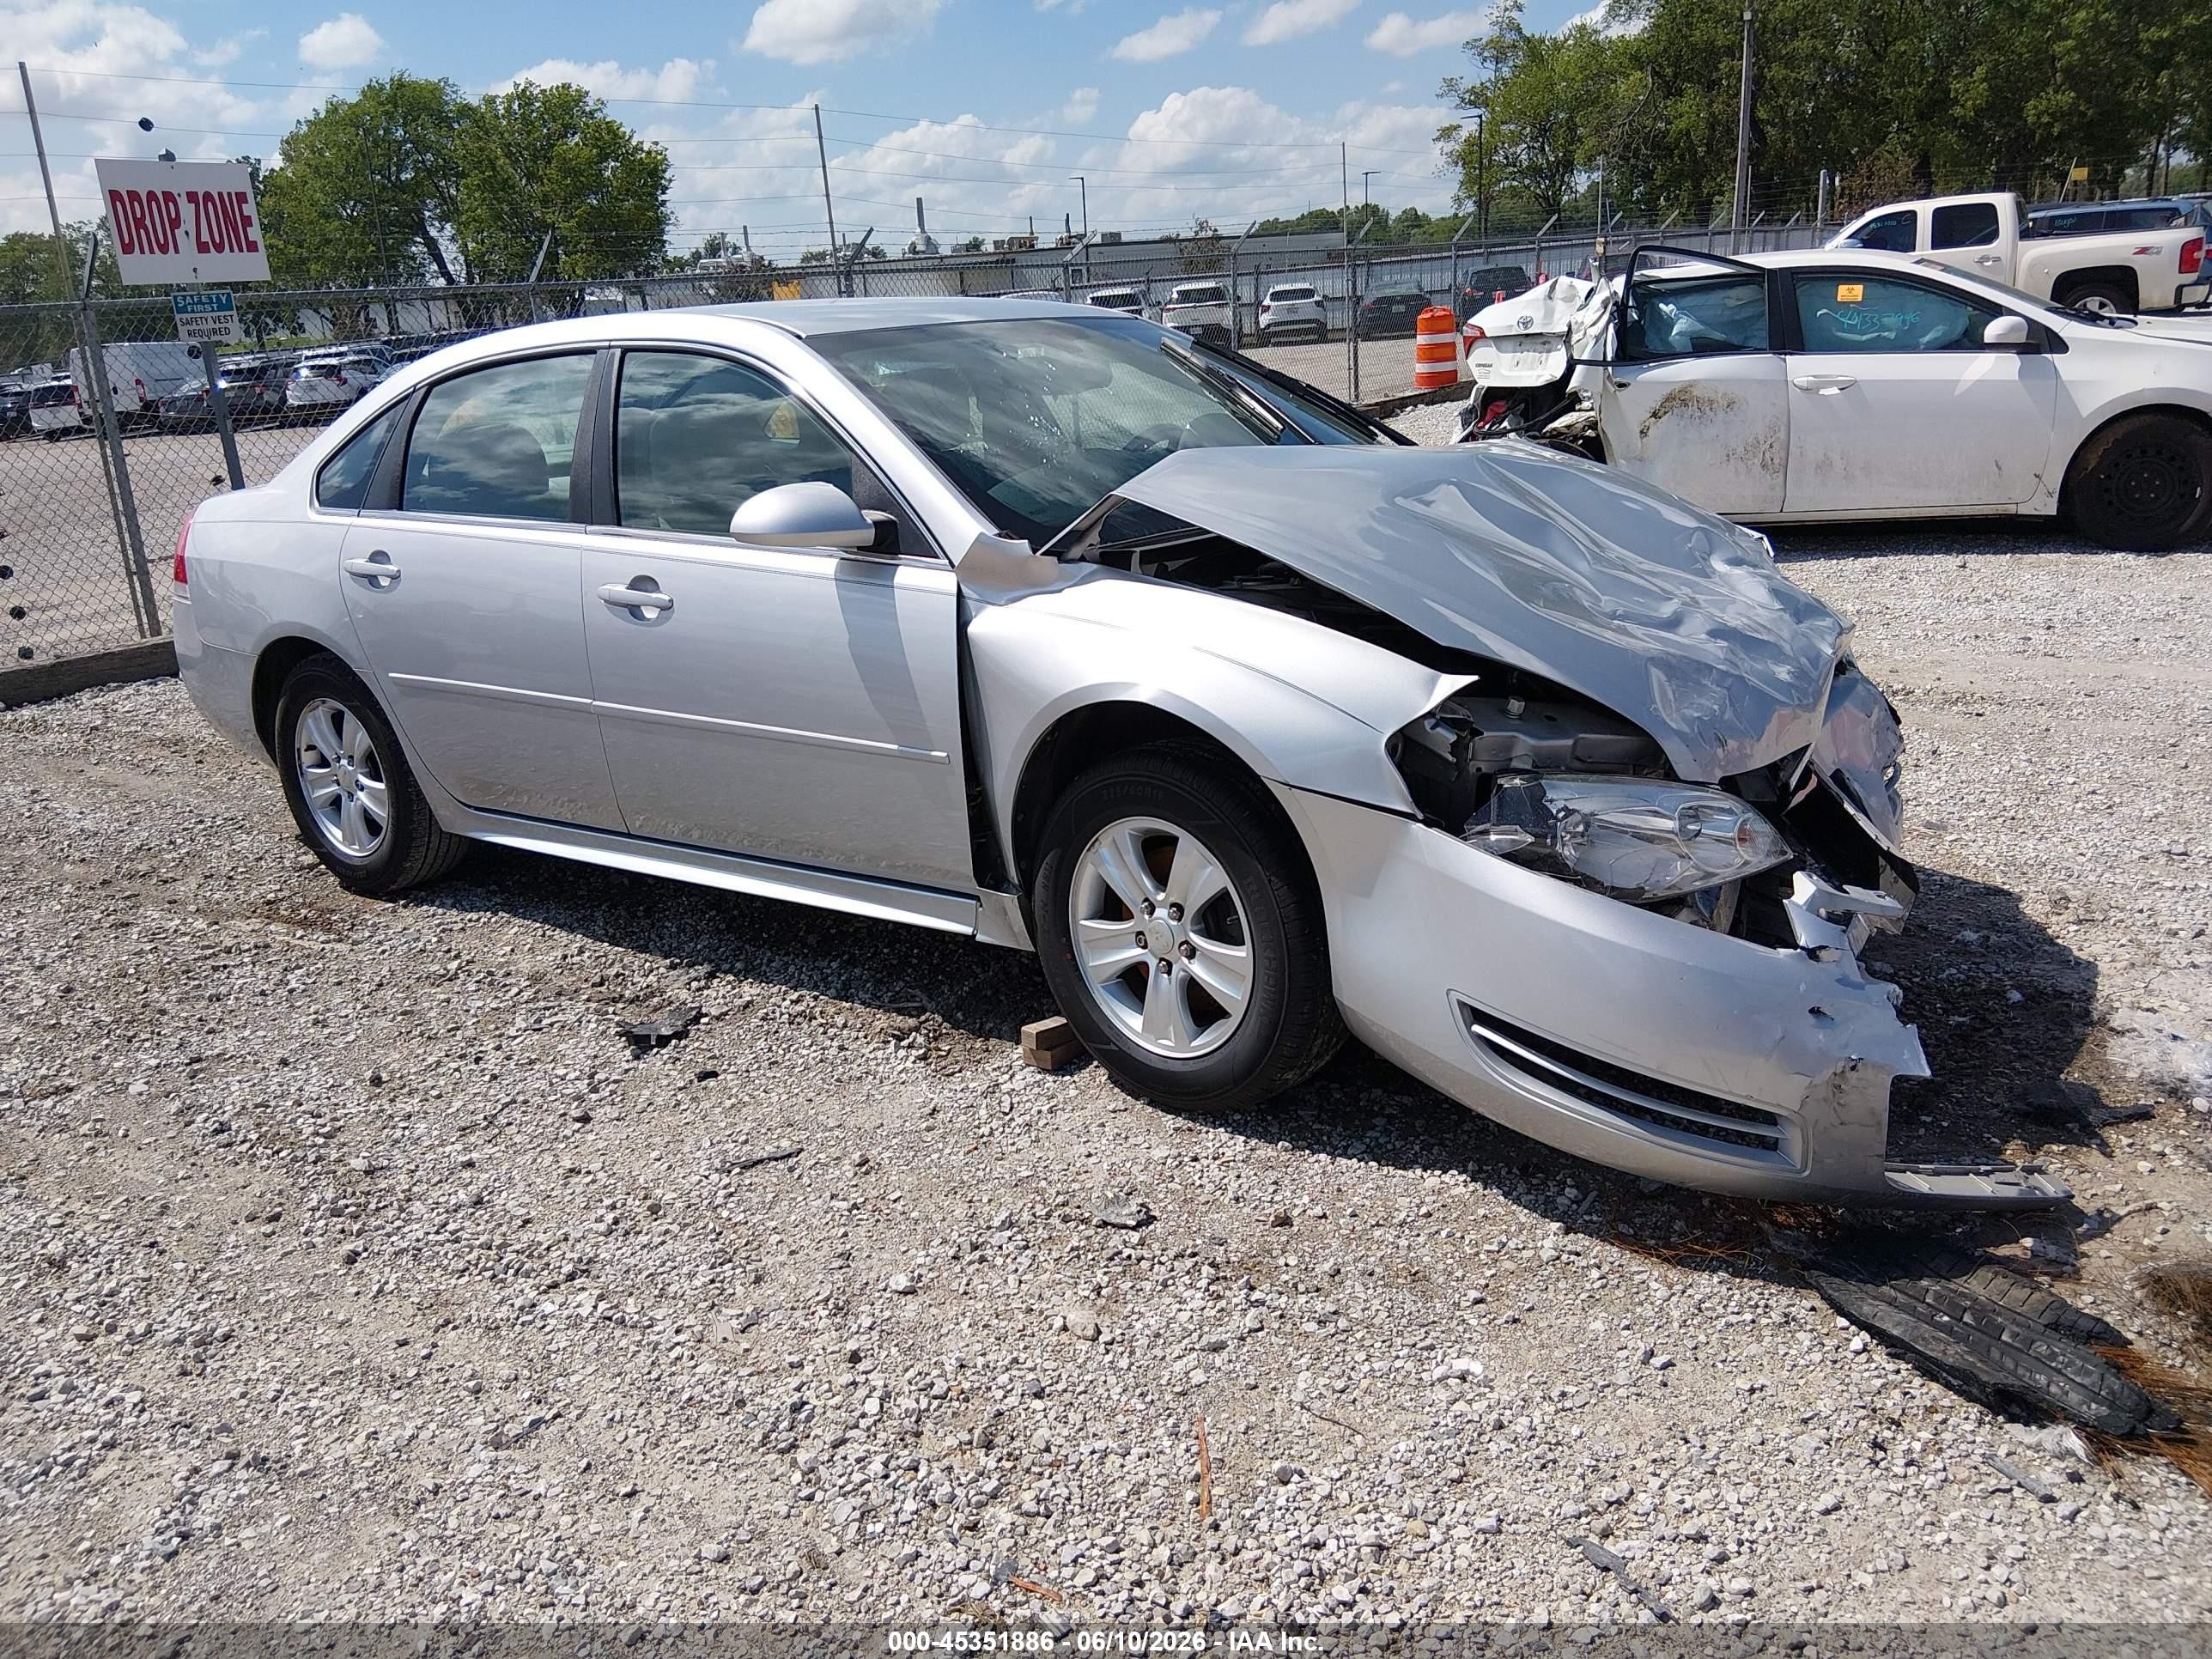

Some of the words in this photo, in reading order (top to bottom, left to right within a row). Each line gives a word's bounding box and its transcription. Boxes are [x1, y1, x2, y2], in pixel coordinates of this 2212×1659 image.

[108, 189, 182, 255] DROP
[185, 191, 259, 254] ZONE
[177, 294, 228, 307] SAFETY
[187, 304, 218, 313] FIRST
[179, 316, 208, 326] SAFETY
[210, 314, 234, 325] VEST
[187, 327, 230, 339] REQUIRED
